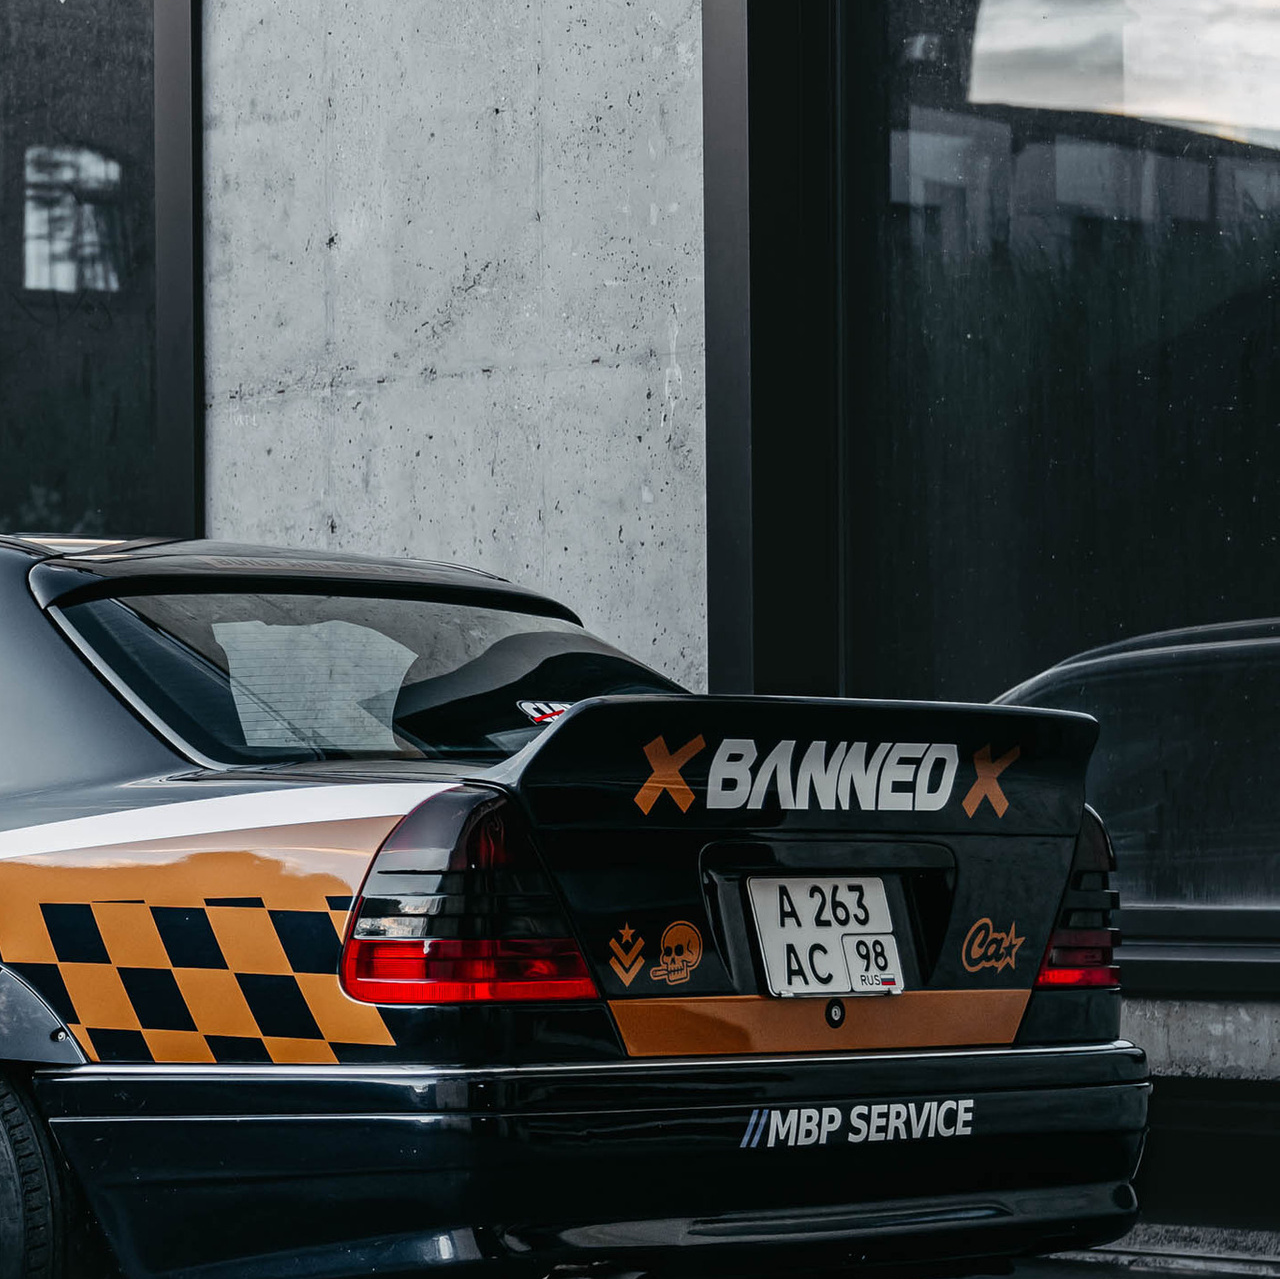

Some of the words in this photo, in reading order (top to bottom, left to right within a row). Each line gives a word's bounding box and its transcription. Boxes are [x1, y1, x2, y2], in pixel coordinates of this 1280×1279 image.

[706, 738, 959, 811] BANNED
[778, 884, 802, 928] A
[808, 884, 870, 927] 263
[785, 942, 834, 986] AC
[855, 939, 889, 972] 98
[860, 975, 881, 986] RUS
[847, 1099, 974, 1143] SERVICE
